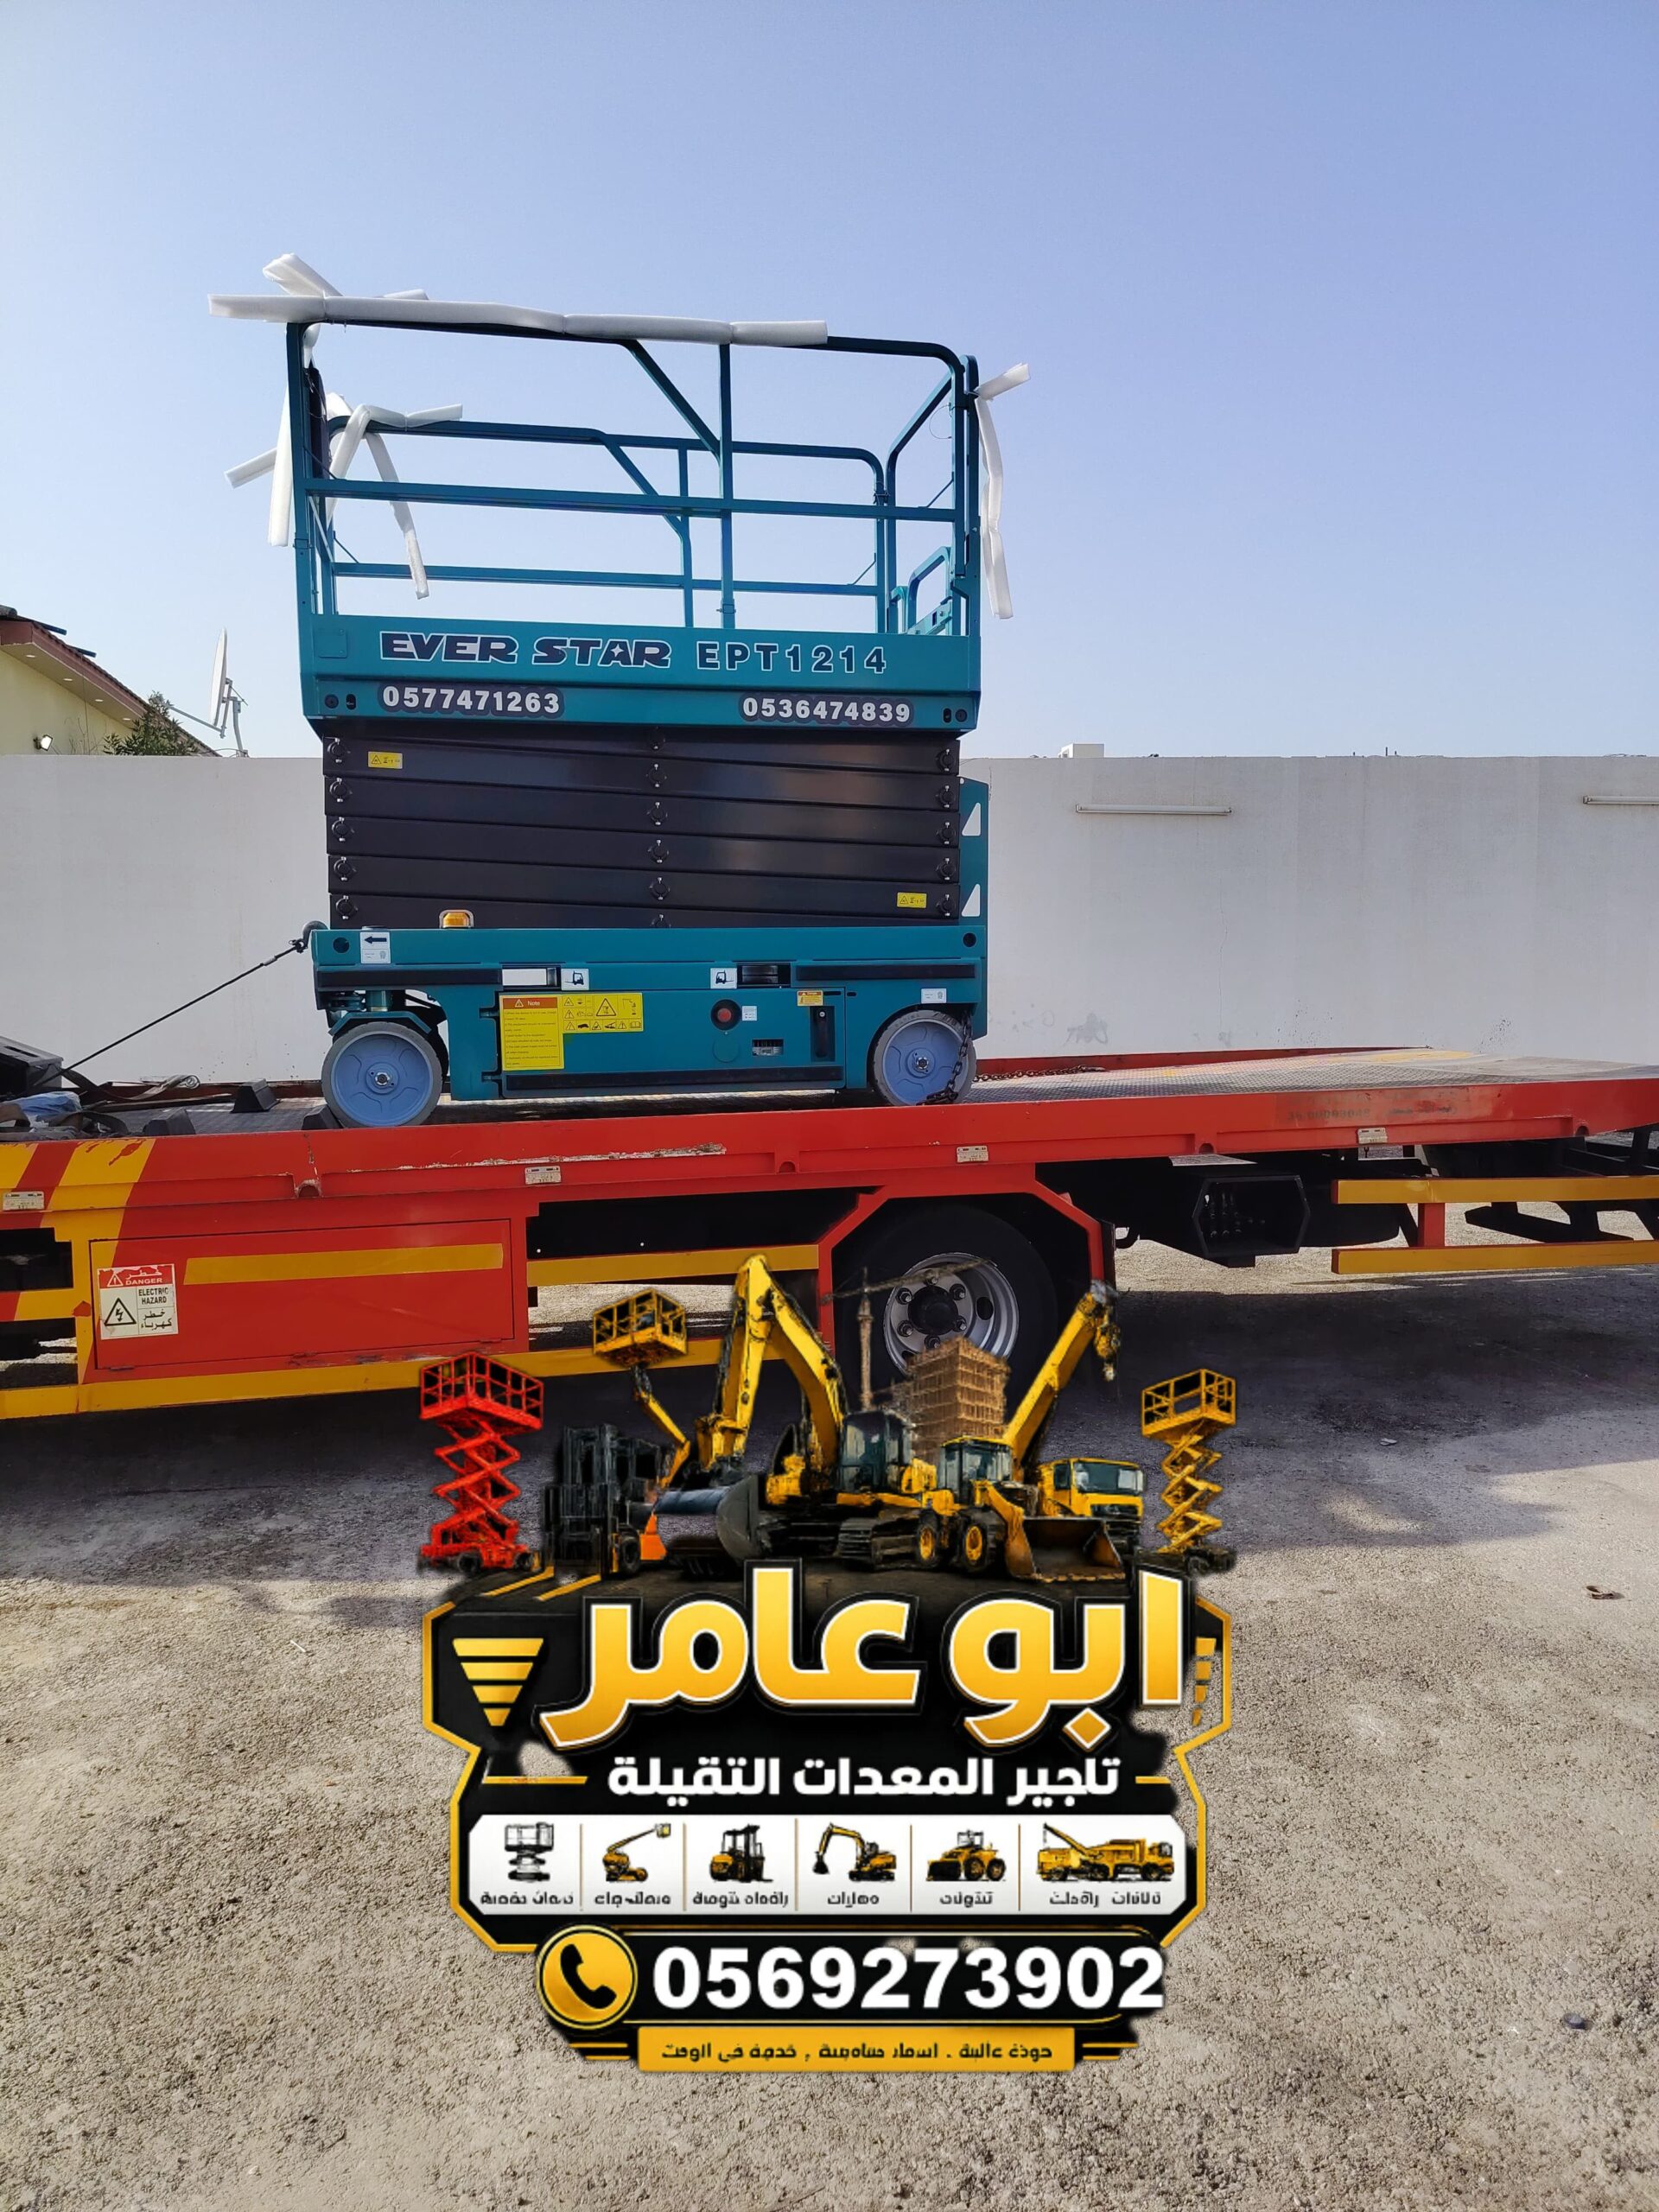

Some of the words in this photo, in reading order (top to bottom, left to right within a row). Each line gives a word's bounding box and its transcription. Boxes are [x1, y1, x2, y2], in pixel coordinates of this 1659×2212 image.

[379, 631, 518, 664] EVER
[531, 637, 671, 668] STAR
[696, 641, 887, 674] EPT1214
[383, 686, 560, 714] 0577471263
[743, 697, 910, 721] 0536474839
[138, 1287, 168, 1296] ELECTRIC
[142, 1296, 167, 1305] HAZARD
[143, 1308, 166, 1320] خطر
[141, 1318, 172, 1331] كهرباء
